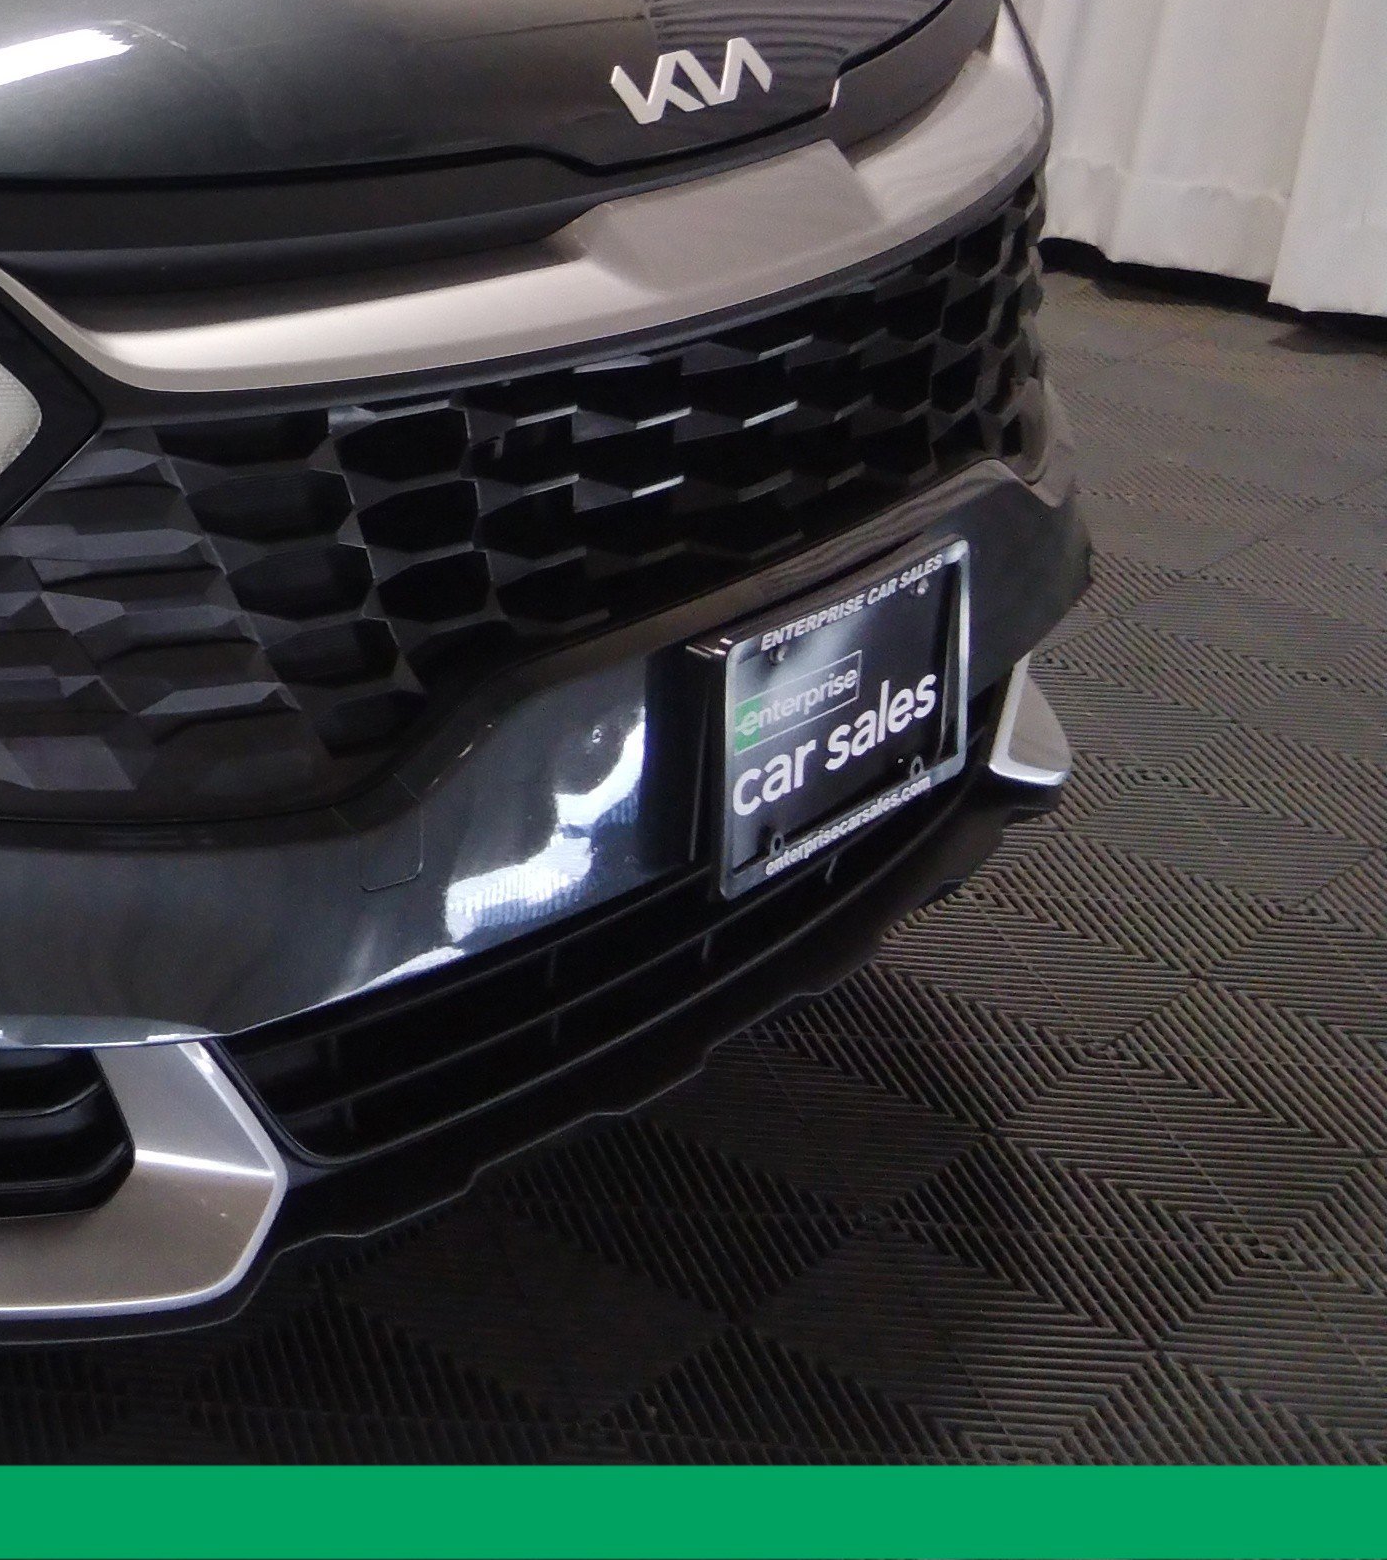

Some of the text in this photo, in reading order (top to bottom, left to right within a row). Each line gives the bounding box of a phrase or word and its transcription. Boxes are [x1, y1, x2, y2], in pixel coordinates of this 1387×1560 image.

[609, 37, 773, 124] KIA
[760, 553, 943, 651] ENTERPRISE CAR SALES
[733, 673, 937, 816] car sales
[735, 669, 858, 735] enterprise
[765, 776, 931, 876] enterprisecarsales.com
